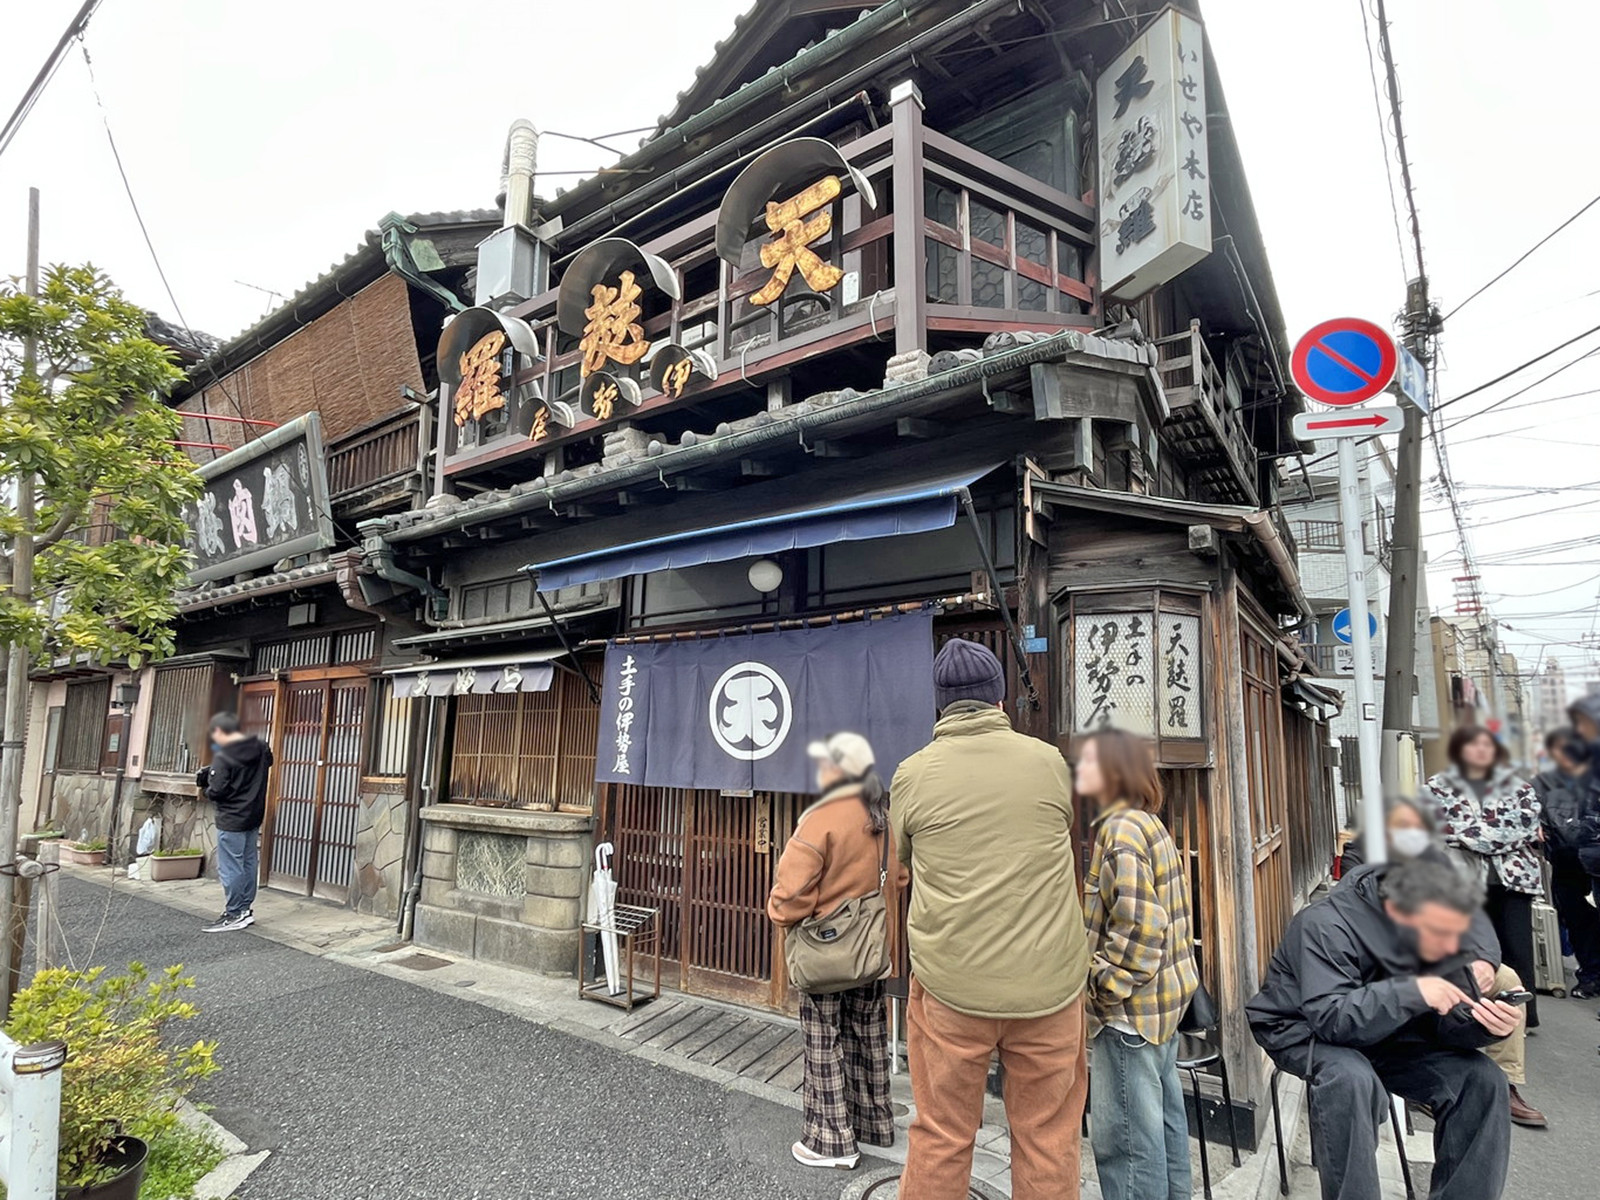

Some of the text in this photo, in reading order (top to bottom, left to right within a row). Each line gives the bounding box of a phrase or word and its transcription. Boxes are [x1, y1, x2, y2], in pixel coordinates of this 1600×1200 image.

[1177, 42, 1206, 221] いせや本店
[1125, 616, 1146, 687] 土手の
[612, 655, 638, 774] 土手の伊勢屋
